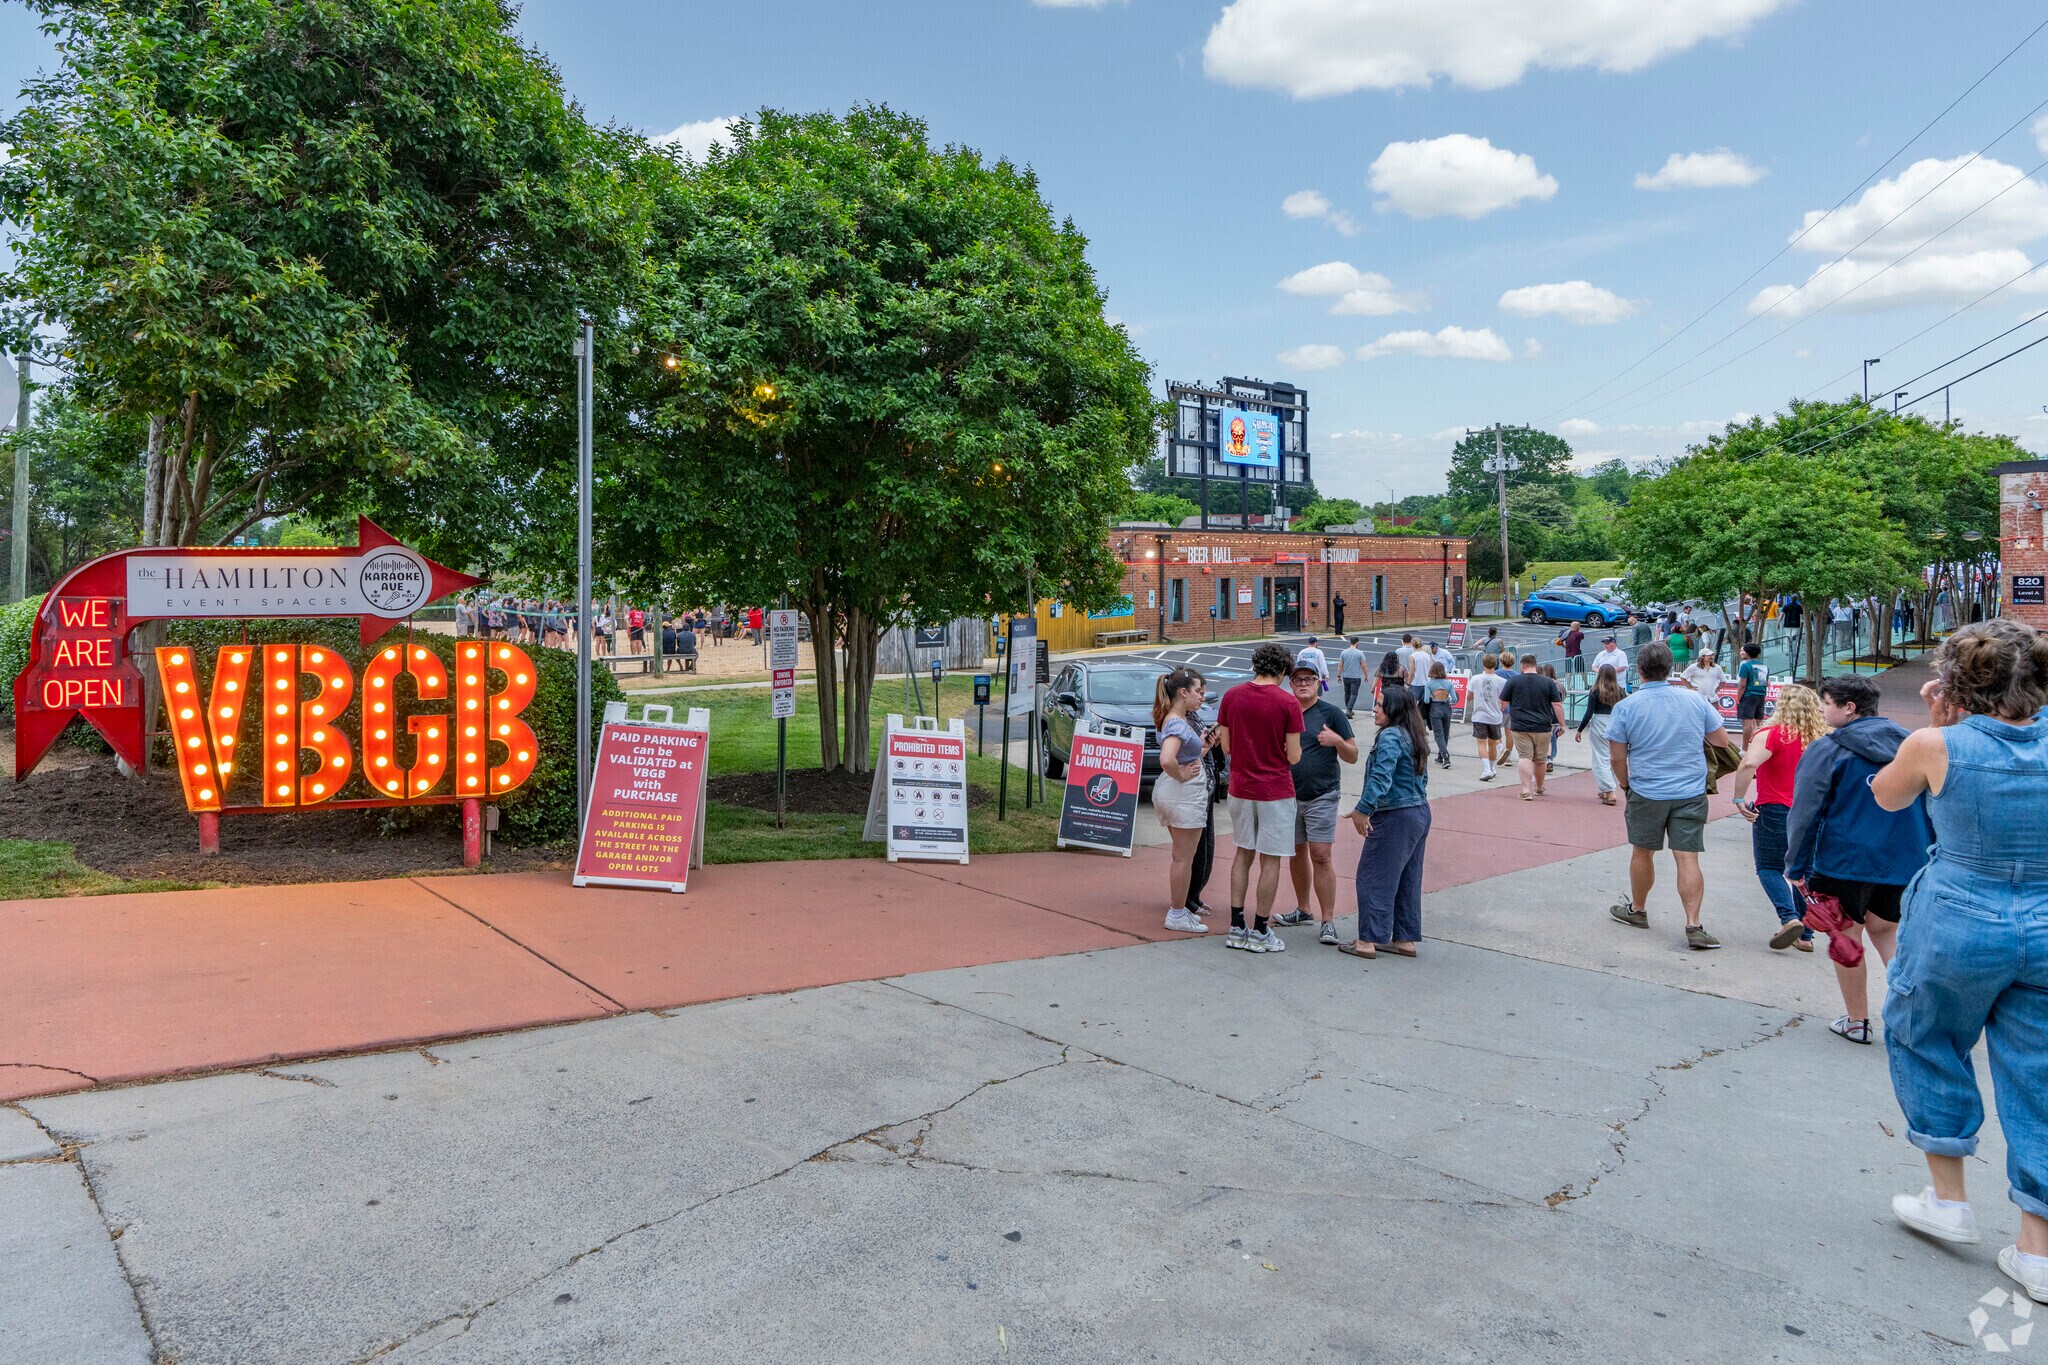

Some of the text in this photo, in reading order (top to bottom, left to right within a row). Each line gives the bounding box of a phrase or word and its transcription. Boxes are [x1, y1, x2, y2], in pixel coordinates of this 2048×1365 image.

[1188, 546, 1208, 563] BEER
[1212, 546, 1232, 563] HALL
[1320, 547, 1360, 563] RESTAURANT
[138, 567, 348, 589] the HAMILTON
[365, 572, 420, 581] KARAOKE
[2018, 577, 2040, 585] 820
[381, 582, 404, 591] AVE
[167, 598, 347, 607] EVENT SPACES
[60, 600, 107, 627] WE
[54, 639, 112, 667] ARE
[43, 679, 122, 708] OPEN
[155, 641, 538, 812] VBGB
[611, 732, 698, 748] PAID PARKING
[633, 747, 673, 757] can be
[893, 741, 960, 756] PROHIBITED ITEMS
[1081, 743, 1134, 762] NO OUTSIDE
[610, 754, 692, 770] VALIDATED at
[1075, 754, 1136, 774] LAWN CHAIRS
[633, 767, 666, 779] VBGB
[633, 779, 661, 790] with
[613, 789, 678, 803] PURCHASE
[602, 809, 683, 822] ADDITIONAL PAID
[613, 821, 654, 830] PARKING
[595, 830, 683, 843] AVAILABLE ACROSS
[595, 840, 612, 848] THE
[614, 842, 646, 851] STREET
[663, 845, 679, 853] THE
[595, 851, 672, 863] GARAGE AND/OR
[608, 863, 659, 873] OPEN LOTS
